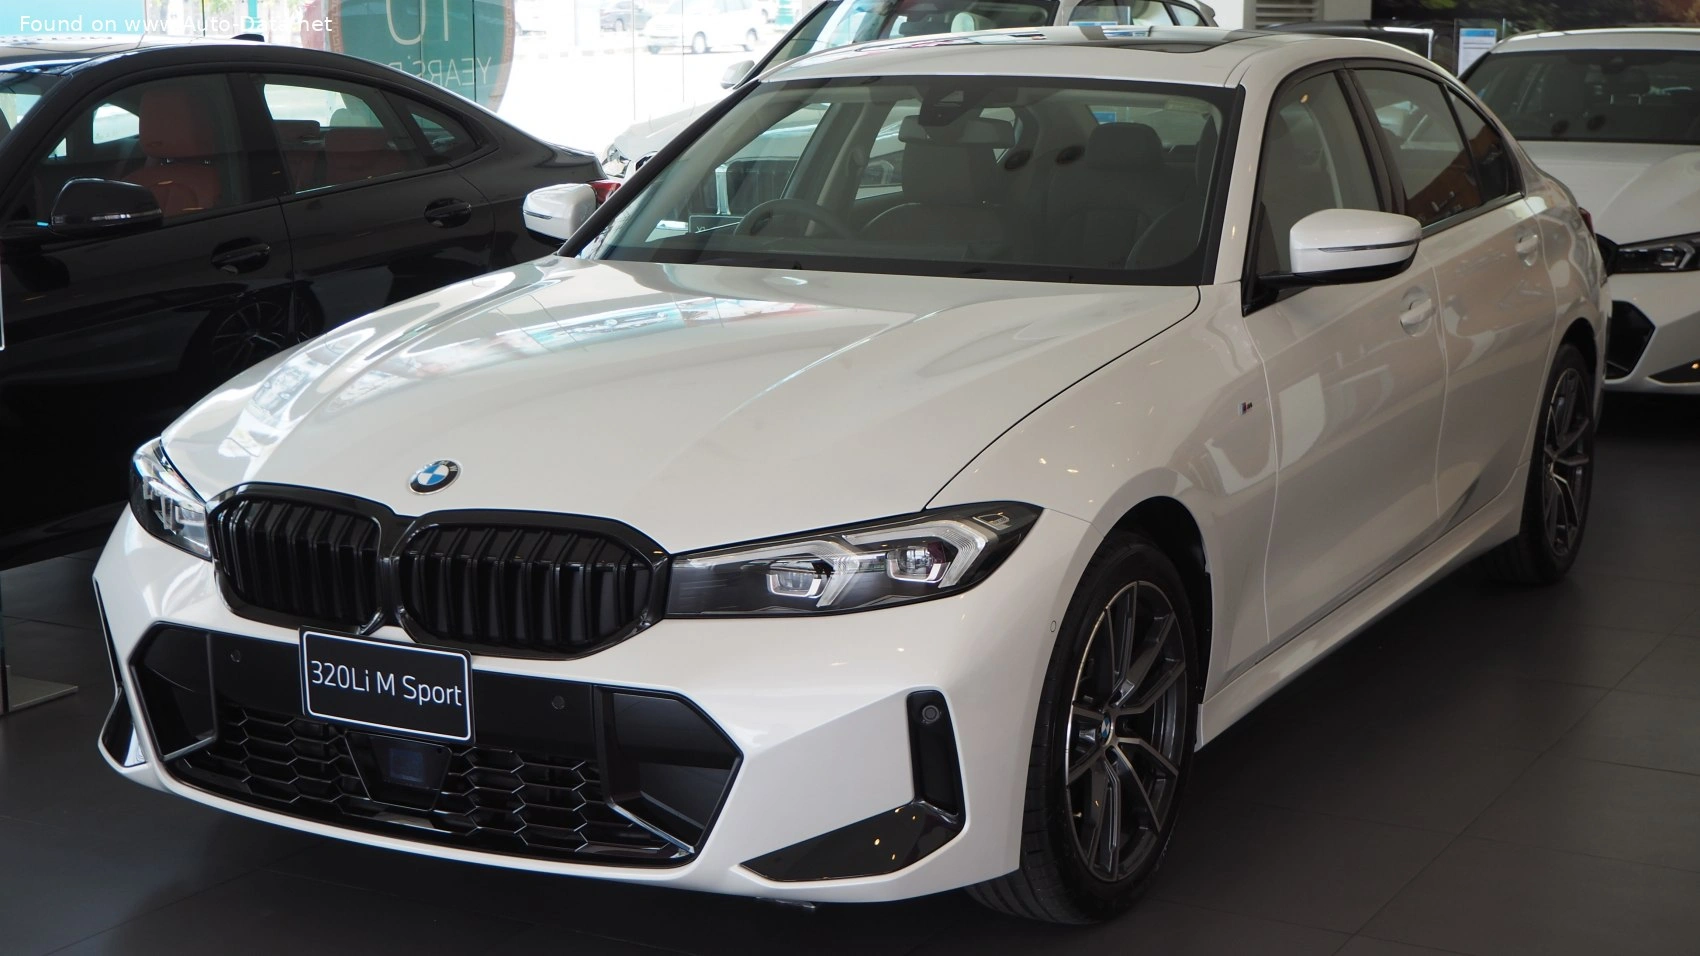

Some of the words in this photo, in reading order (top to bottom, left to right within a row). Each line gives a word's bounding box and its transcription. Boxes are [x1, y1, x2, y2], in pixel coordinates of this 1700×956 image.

[311, 660, 370, 692] 320Li
[376, 671, 396, 697] M
[402, 675, 463, 707] Sport
